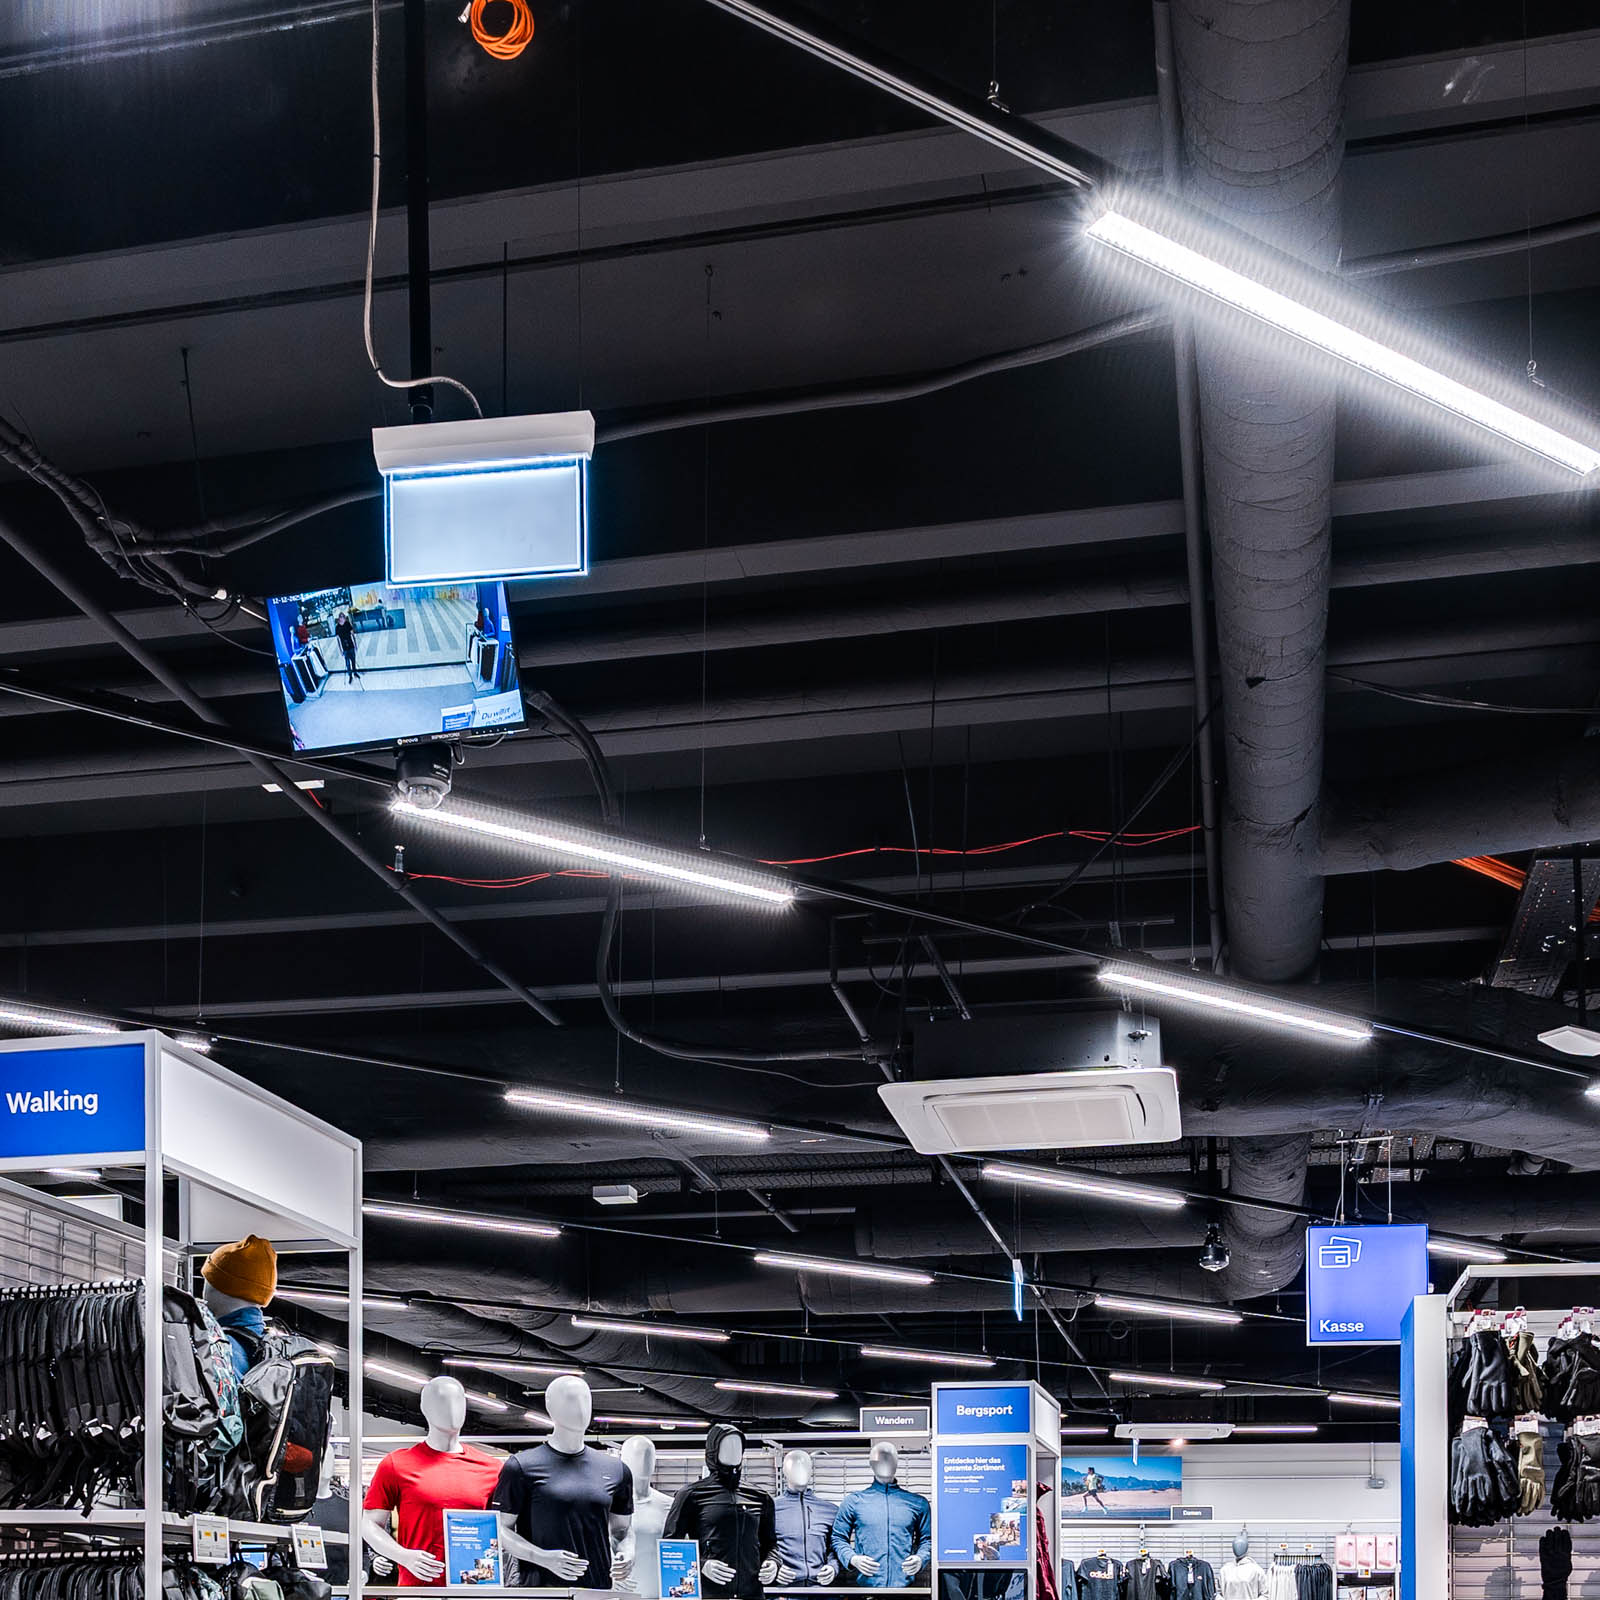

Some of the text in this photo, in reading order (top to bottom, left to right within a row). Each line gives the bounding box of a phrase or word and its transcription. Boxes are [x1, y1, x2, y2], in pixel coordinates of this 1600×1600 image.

[6, 1088, 98, 1115] Walking
[1319, 1318, 1364, 1334] Kasse
[956, 1405, 1013, 1418] Bergsport
[875, 1416, 914, 1425] Wandern
